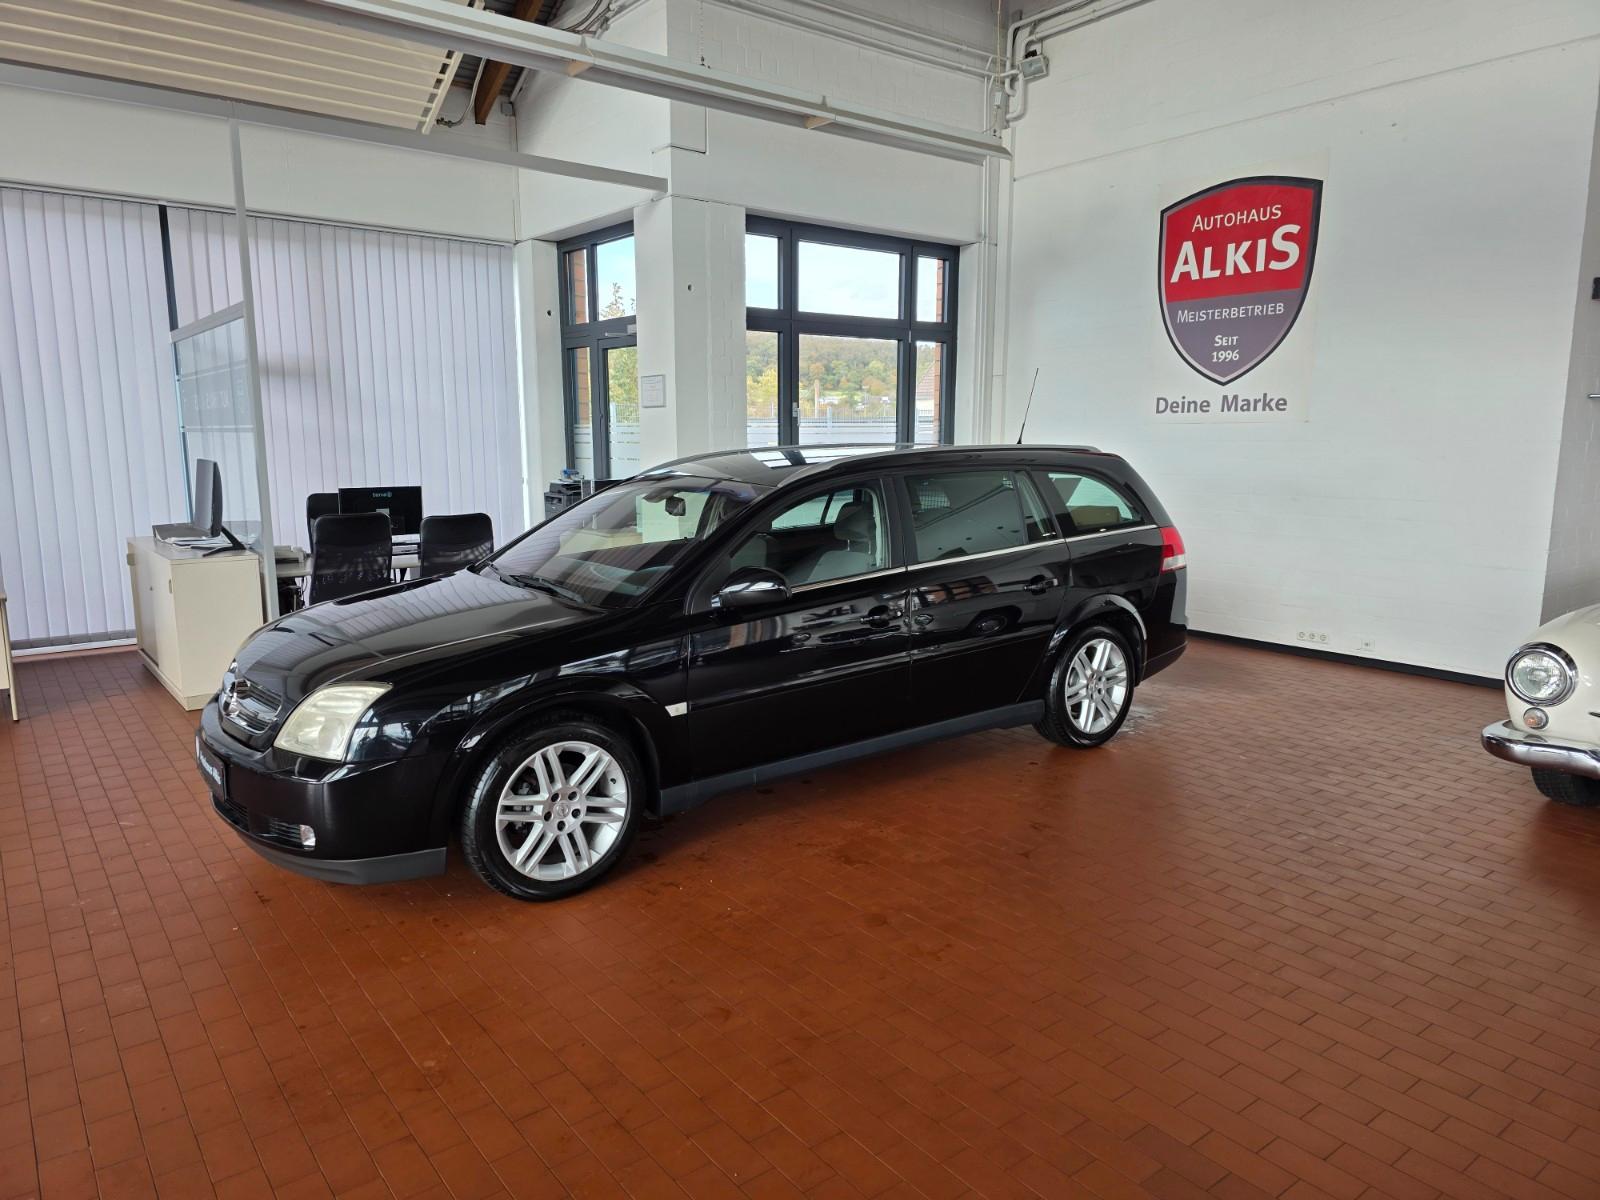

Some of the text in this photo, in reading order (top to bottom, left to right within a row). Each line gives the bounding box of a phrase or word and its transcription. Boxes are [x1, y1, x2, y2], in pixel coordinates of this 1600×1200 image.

[1192, 204, 1282, 232] AUTOHAUS
[1170, 224, 1301, 283] ALKIS
[1177, 302, 1284, 323] MEISTERBETRIEB
[1214, 335, 1239, 347] SEIT
[1211, 349, 1240, 362] 1996
[1155, 392, 1288, 414] Deine Marke
